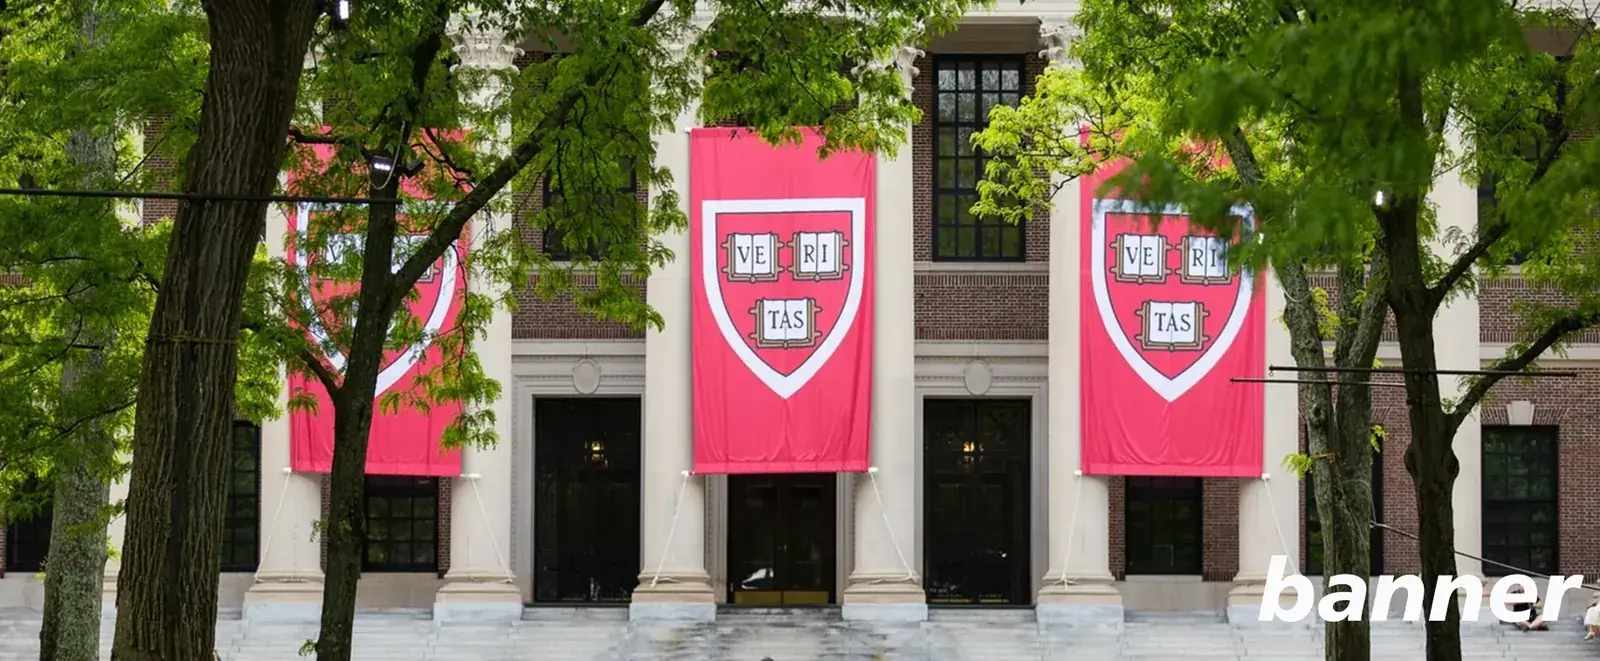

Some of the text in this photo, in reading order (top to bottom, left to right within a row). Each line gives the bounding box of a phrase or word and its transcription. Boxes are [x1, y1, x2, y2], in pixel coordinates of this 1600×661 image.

[737, 244, 828, 264] VE RI
[1125, 246, 1216, 267] VE RI
[768, 310, 804, 329] TAS
[1154, 312, 1191, 332] TAS
